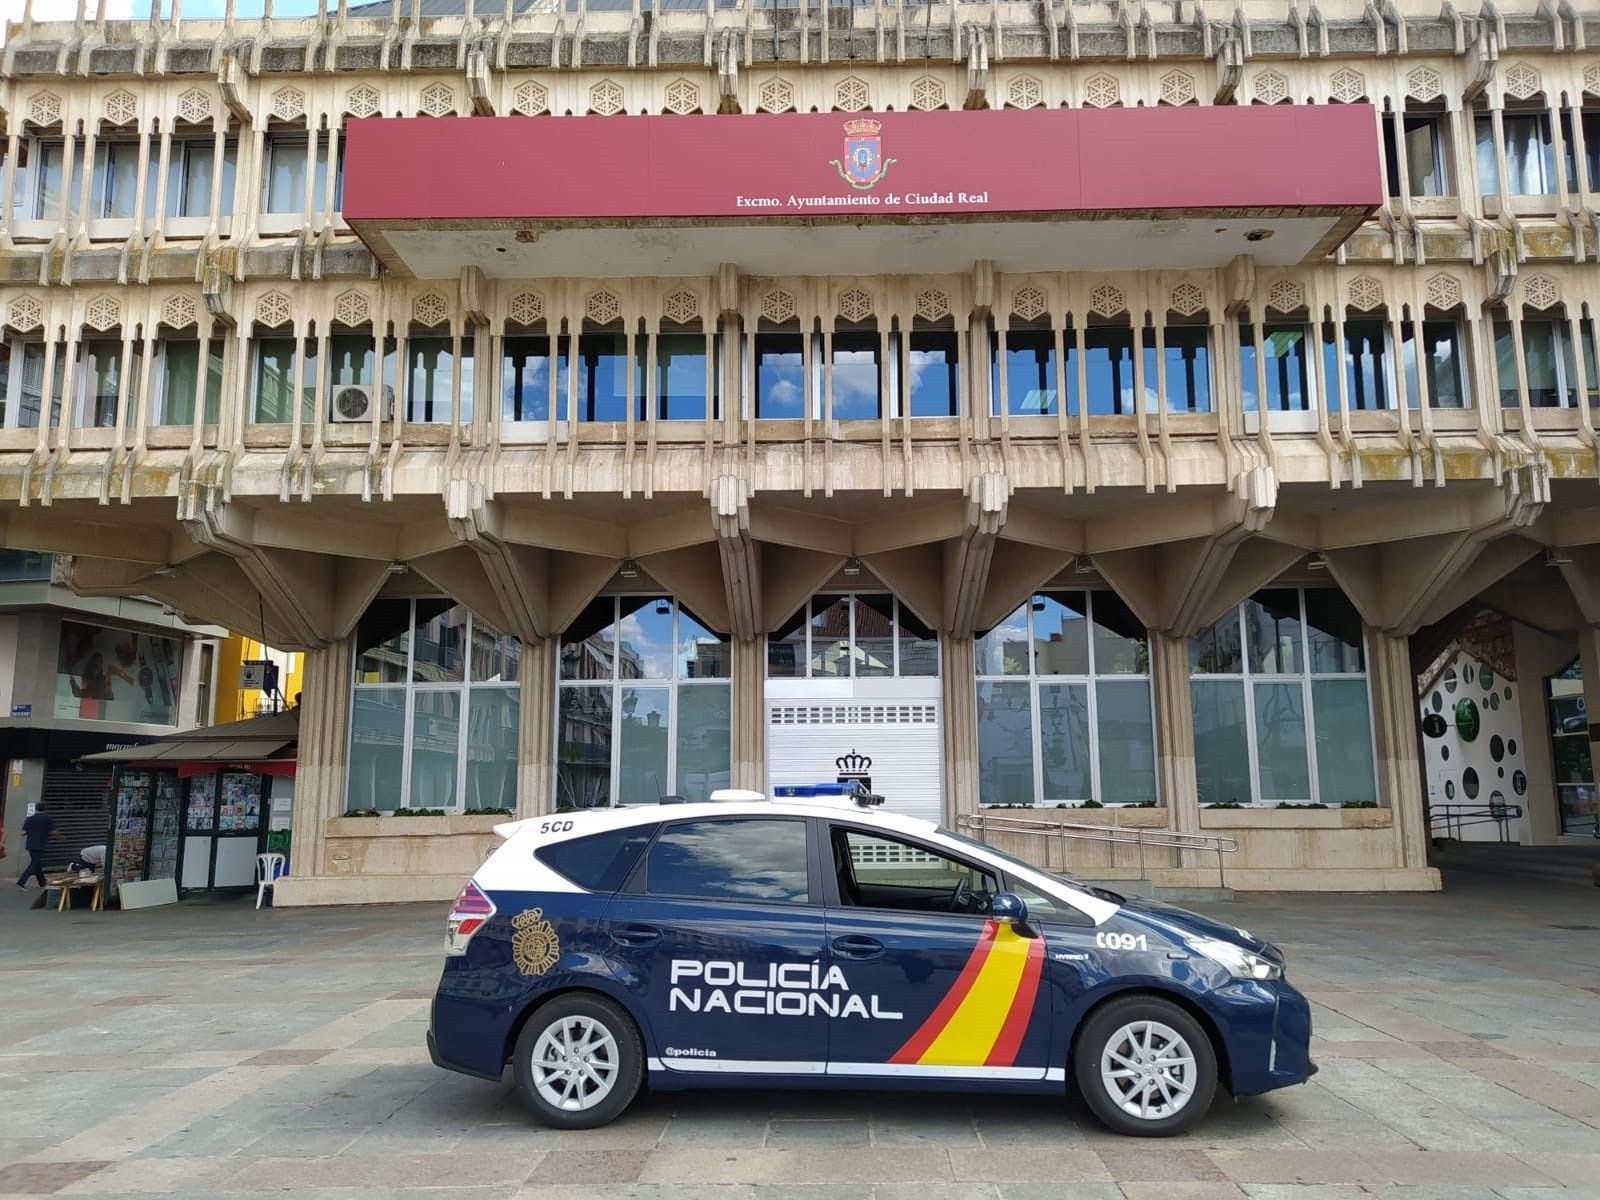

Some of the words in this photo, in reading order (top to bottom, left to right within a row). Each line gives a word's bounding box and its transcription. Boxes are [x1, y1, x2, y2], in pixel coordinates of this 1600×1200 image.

[736, 195, 783, 207] Excmo.
[787, 194, 881, 210] Ayuntamiento
[884, 193, 901, 205] de
[905, 192, 954, 205] Ciudad
[958, 191, 989, 204] Real
[540, 820, 574, 834] 5CD
[670, 959, 849, 991] POLICÍA
[669, 987, 904, 1020] NACIONAL
[665, 1046, 717, 1058] @policia
